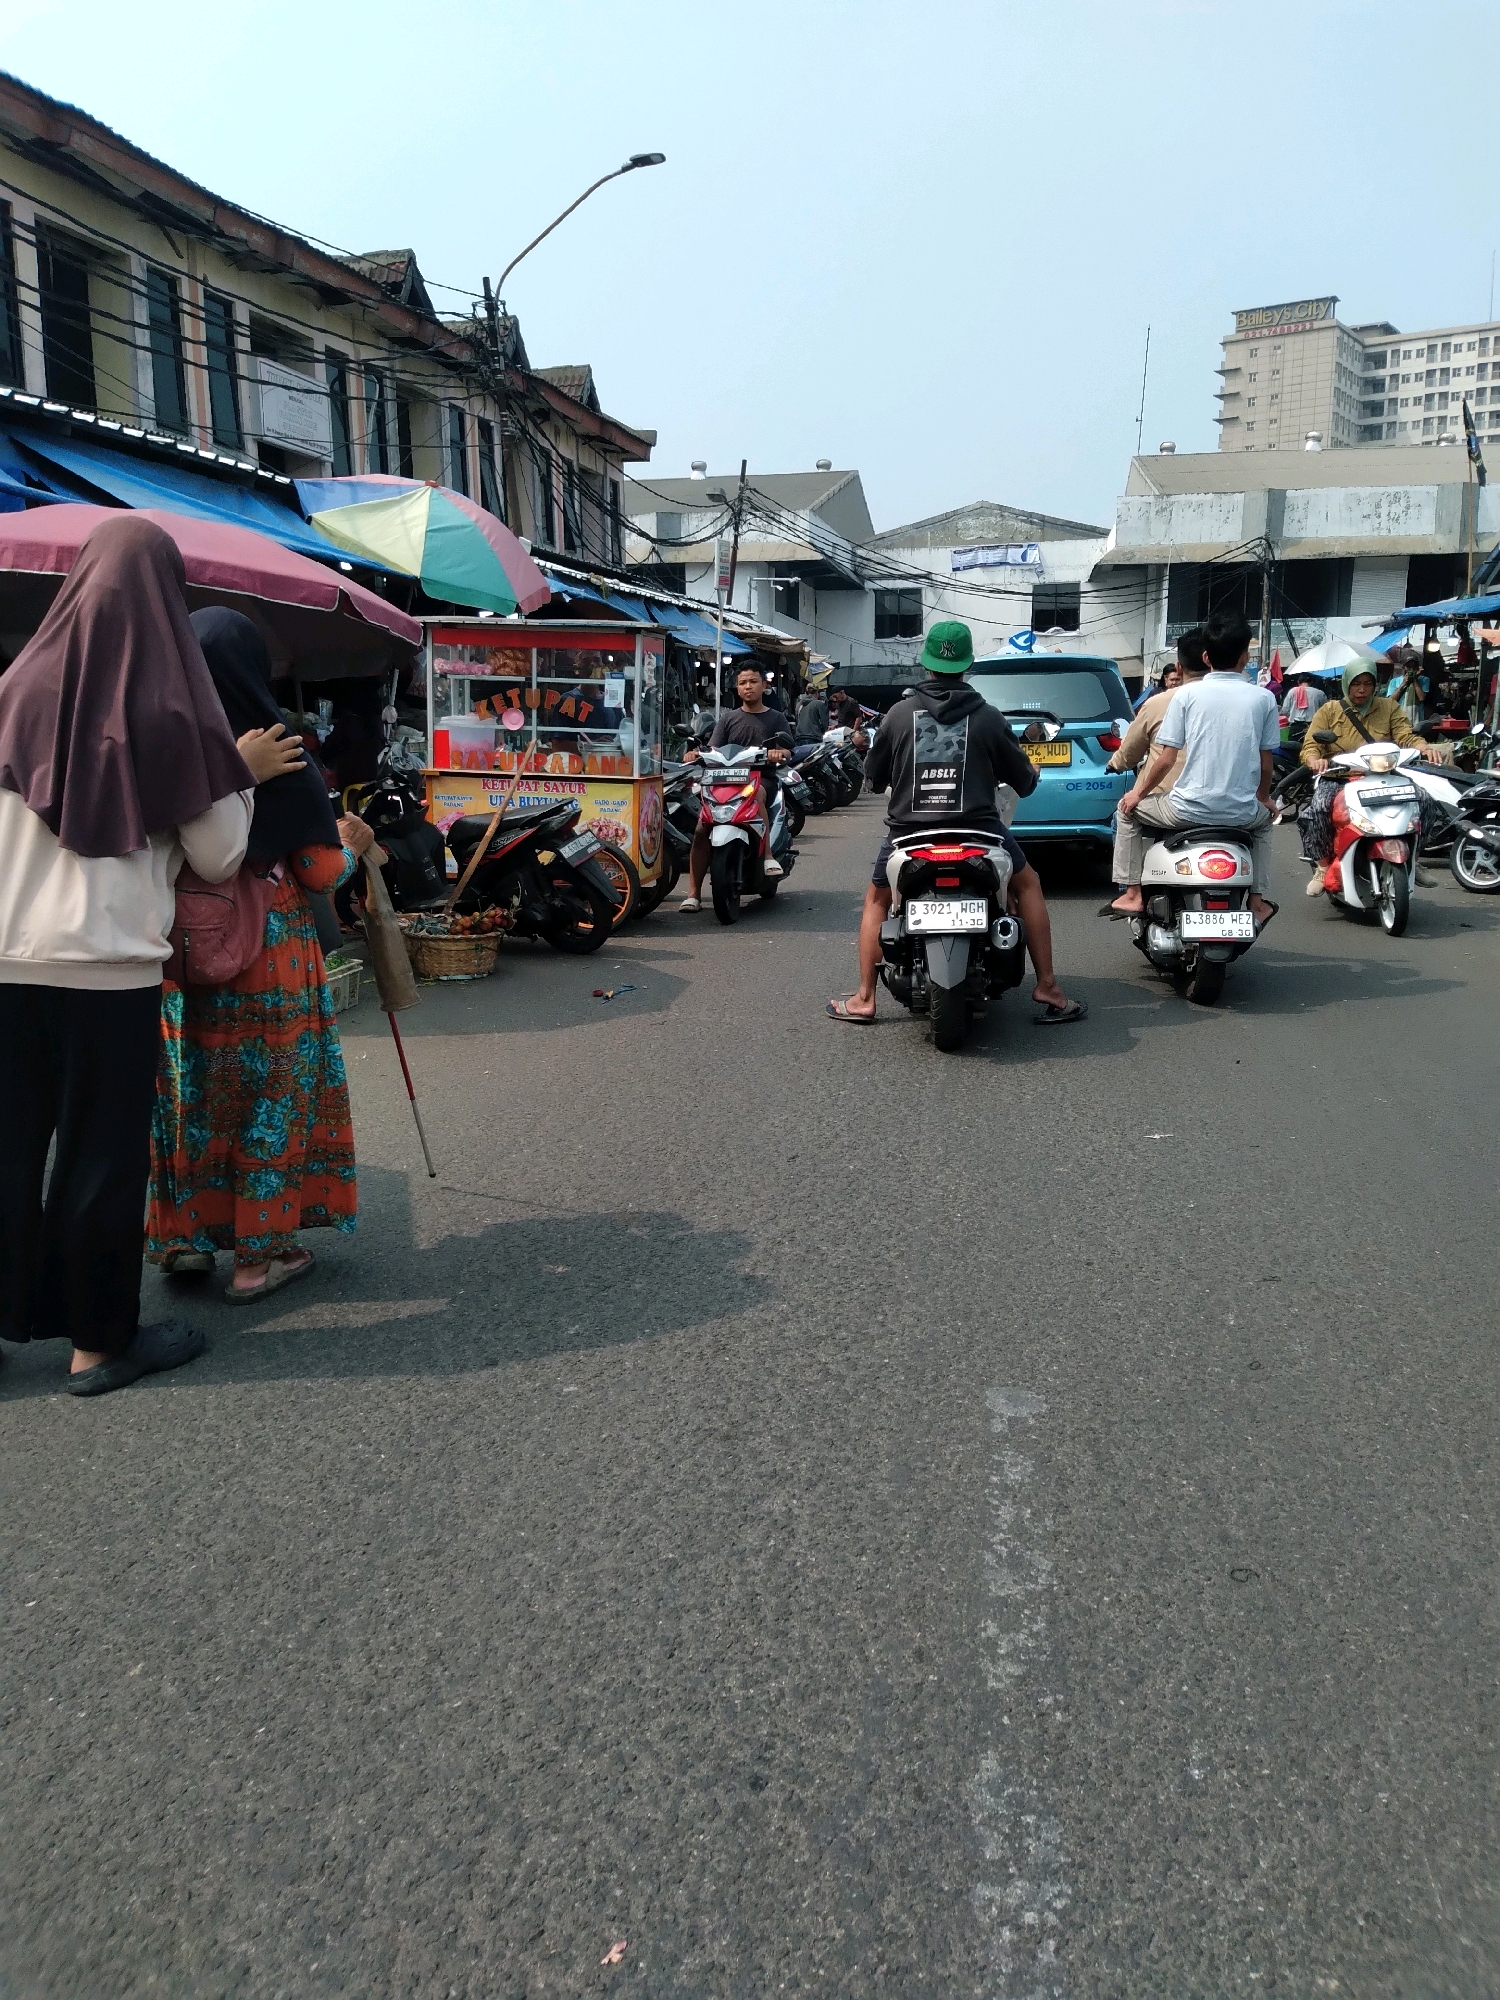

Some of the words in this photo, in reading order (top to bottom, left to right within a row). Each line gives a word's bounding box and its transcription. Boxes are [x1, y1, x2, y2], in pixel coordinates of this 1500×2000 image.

[1236, 305, 1292, 327] Bailey's
[1295, 300, 1331, 320] City
[474, 687, 594, 723] KETUPAT
[1046, 743, 1069, 757] WUD
[533, 752, 633, 776] PADANG
[543, 780, 588, 795] SAYUR
[1066, 782, 1083, 791] OE
[1085, 781, 1113, 791] 2054
[518, 795, 579, 810] BUYUG
[909, 904, 917, 916] B
[922, 903, 952, 915] 3921
[960, 902, 985, 914] WGH
[1185, 913, 1192, 925] B
[1198, 913, 1225, 925] 3886
